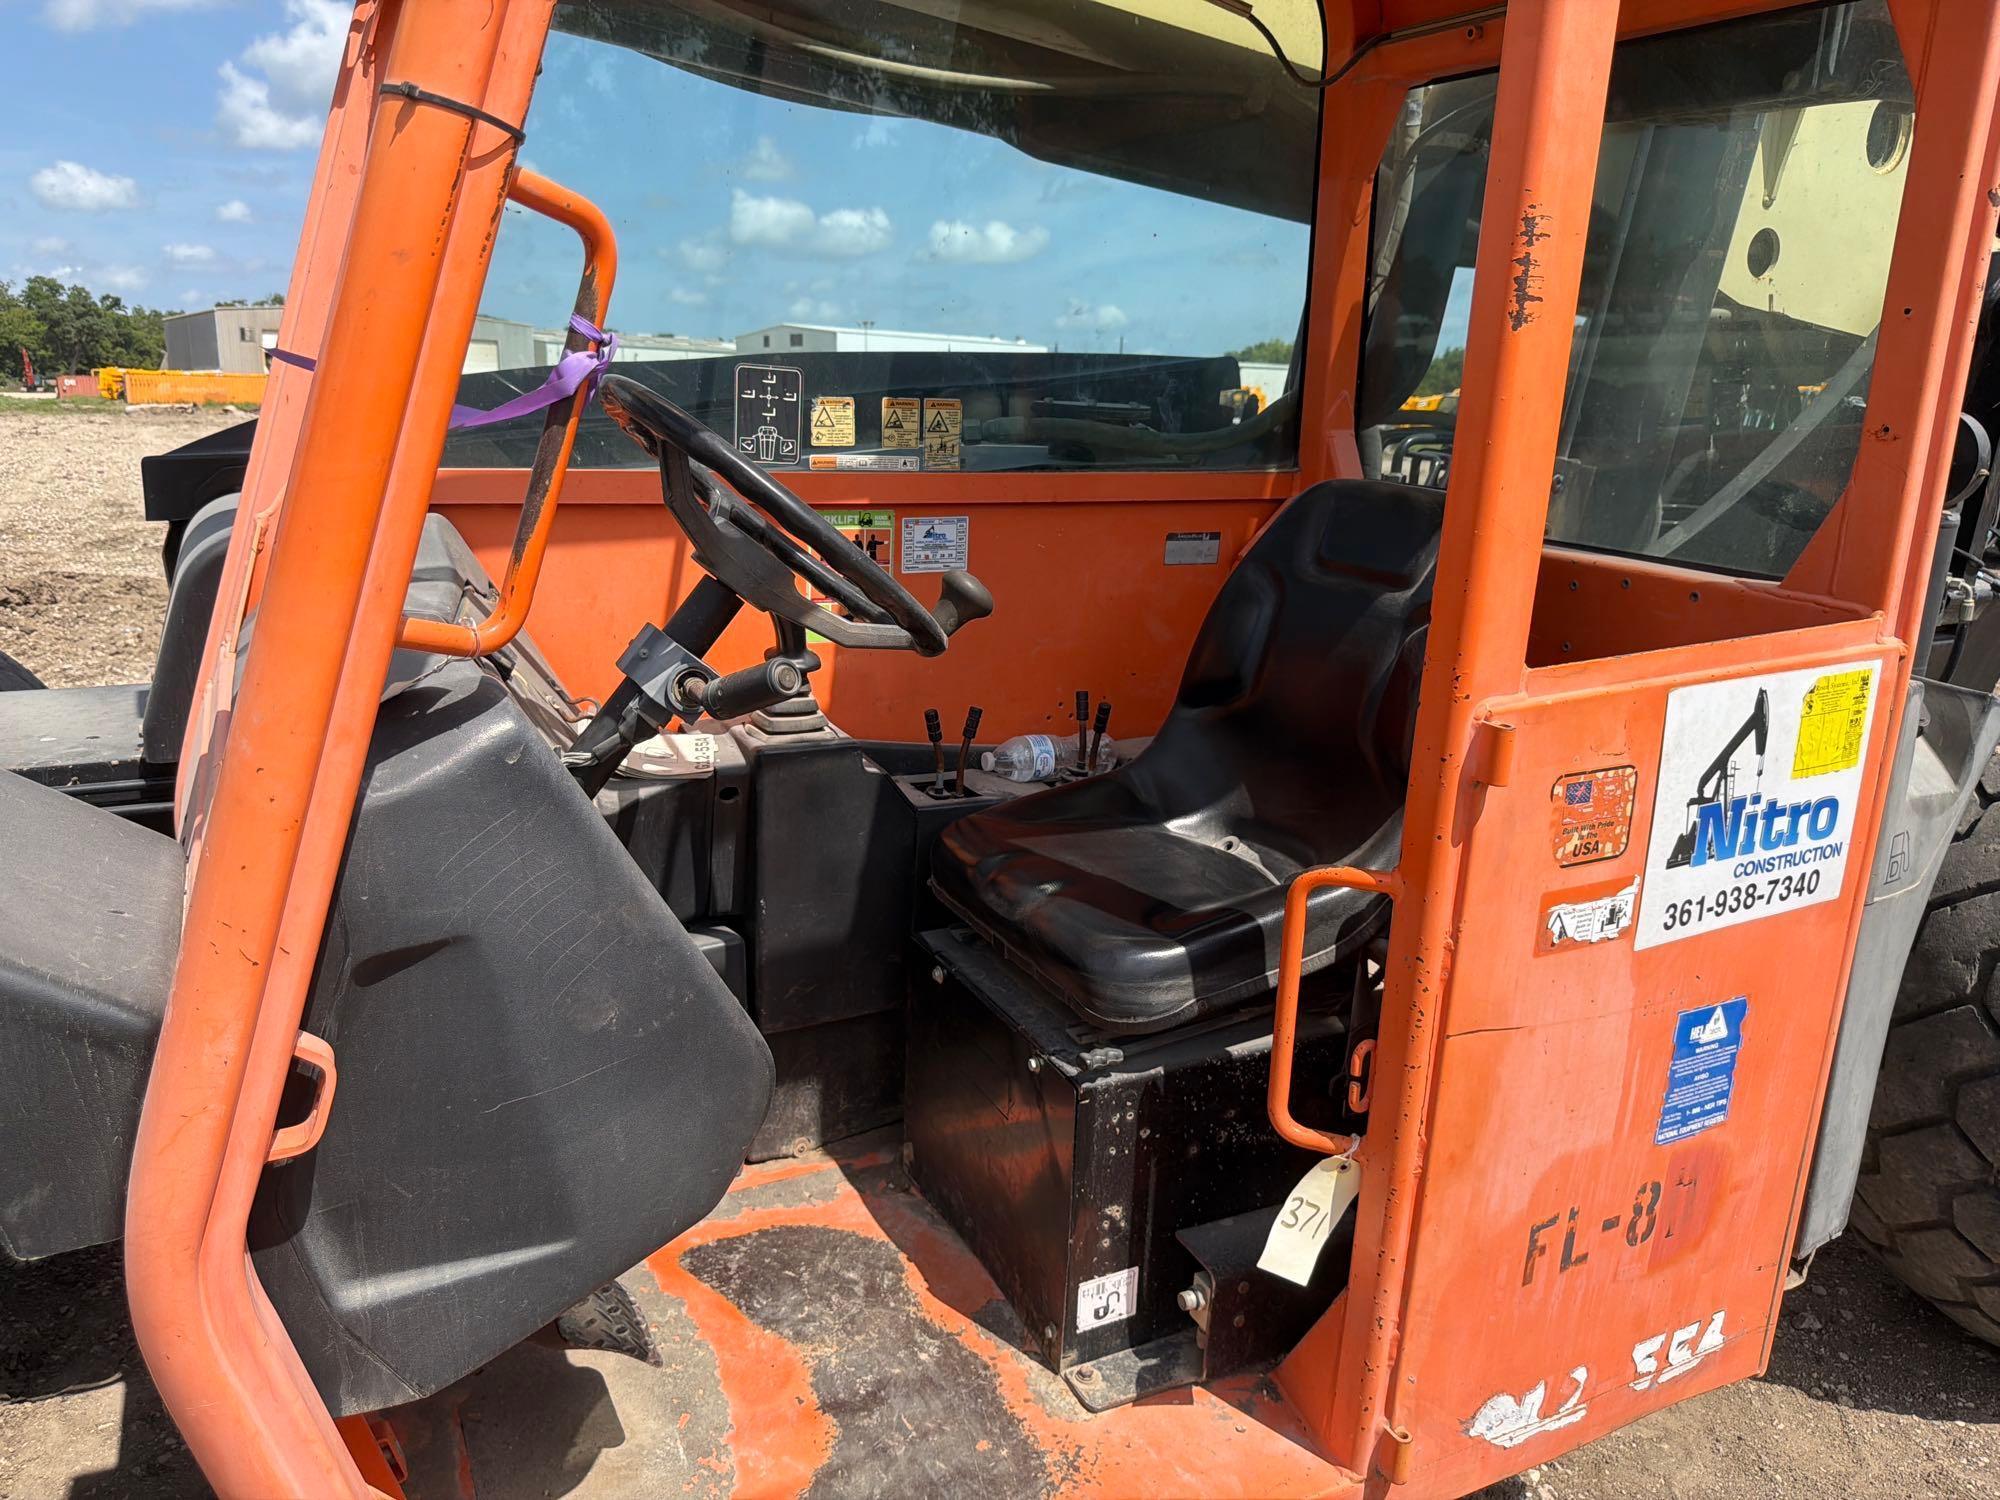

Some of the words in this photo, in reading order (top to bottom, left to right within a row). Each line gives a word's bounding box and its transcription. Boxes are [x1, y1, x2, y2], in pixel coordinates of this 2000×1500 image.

[824, 515, 860, 525] RKLIFT
[694, 737, 710, 770] G12-55A
[1562, 826, 1579, 835] Built
[1580, 823, 1596, 832] With
[1597, 819, 1615, 829] Pride
[1689, 792, 1840, 868] Nitro
[1573, 841, 1600, 857] USA
[1733, 842, 1843, 879] CONSTRUCTION
[1663, 868, 1821, 931] 361-938-7340
[1695, 1042, 1719, 1053] WARNING
[1280, 1195, 1330, 1240] 371
